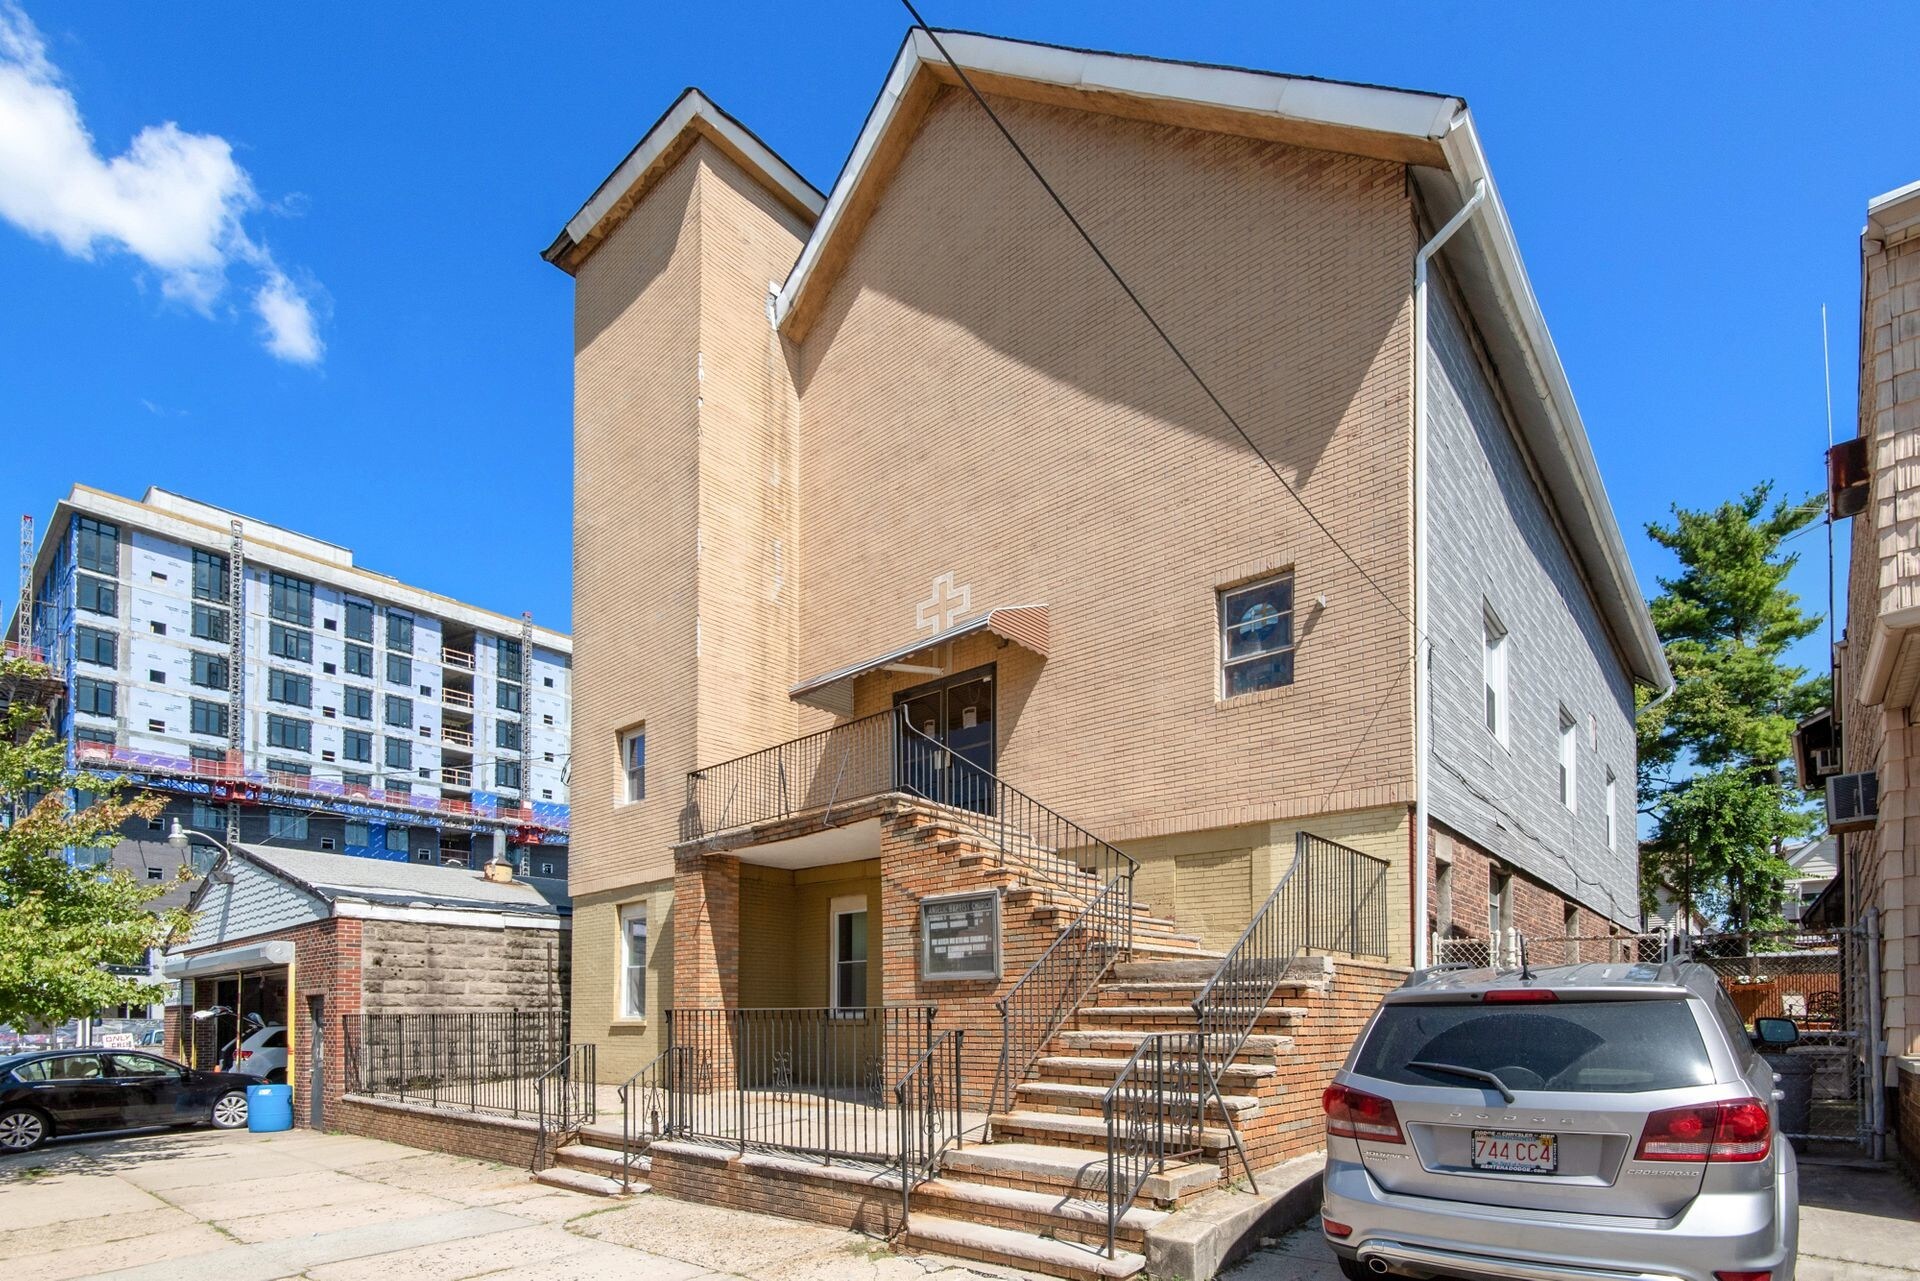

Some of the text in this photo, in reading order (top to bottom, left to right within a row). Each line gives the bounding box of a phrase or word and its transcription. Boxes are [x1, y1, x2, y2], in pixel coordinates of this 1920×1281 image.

[105, 1034, 130, 1042] ONLY
[1476, 1140, 1509, 1159] 744
[1516, 1142, 1551, 1162] CC4
[1626, 1168, 1700, 1177] CROSSROAD
